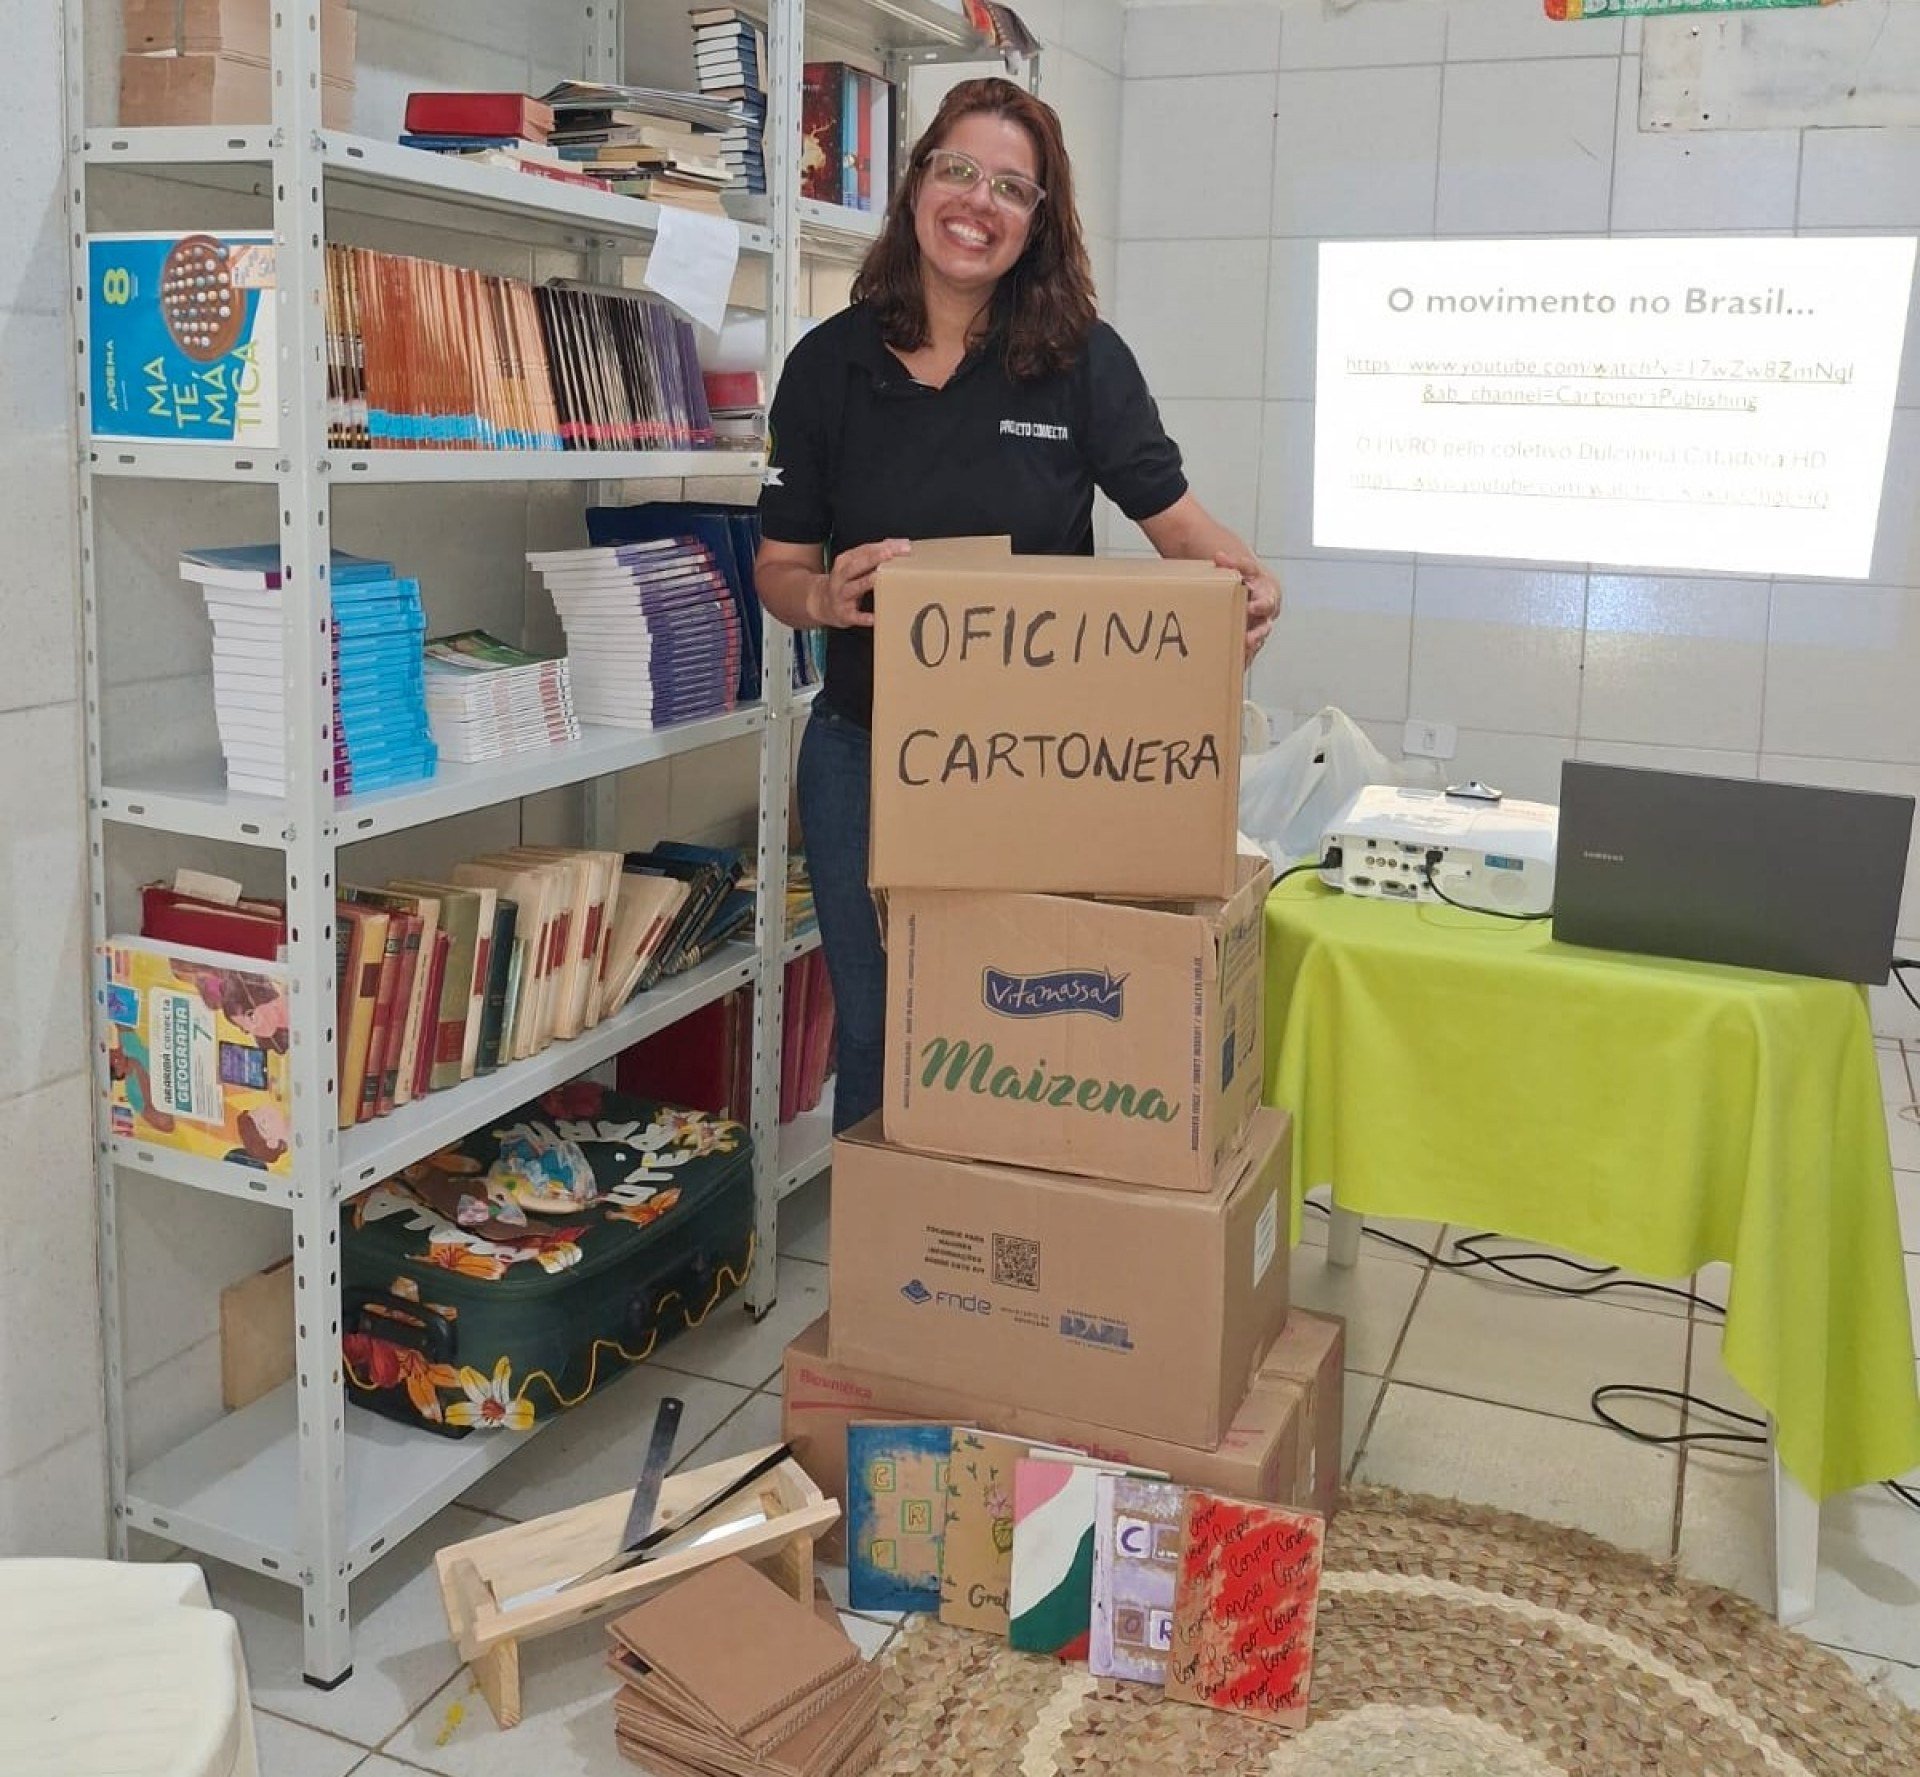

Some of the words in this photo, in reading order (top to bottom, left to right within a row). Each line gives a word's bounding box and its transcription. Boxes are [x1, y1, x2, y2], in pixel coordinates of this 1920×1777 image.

[103, 267, 130, 304] 8
[1388, 287, 1414, 312] O
[1426, 287, 1616, 313] movimento
[1629, 295, 1670, 314] no
[1685, 288, 1815, 315] Brasil...
[105, 339, 118, 411] APOEMA
[143, 357, 171, 417] MA
[192, 364, 231, 426] MÁ
[231, 341, 261, 433] TICA
[173, 382, 201, 429] TE
[910, 602, 1189, 668] OFICINA
[899, 729, 1221, 787] CARTONERA
[175, 1007, 190, 1102] GEOGRAFIA
[920, 1036, 1180, 1123] Maizena
[1121, 1526, 1145, 1554] C
[1230, 1536, 1271, 1577] Corpo
[1213, 1582, 1264, 1630] Corpo
